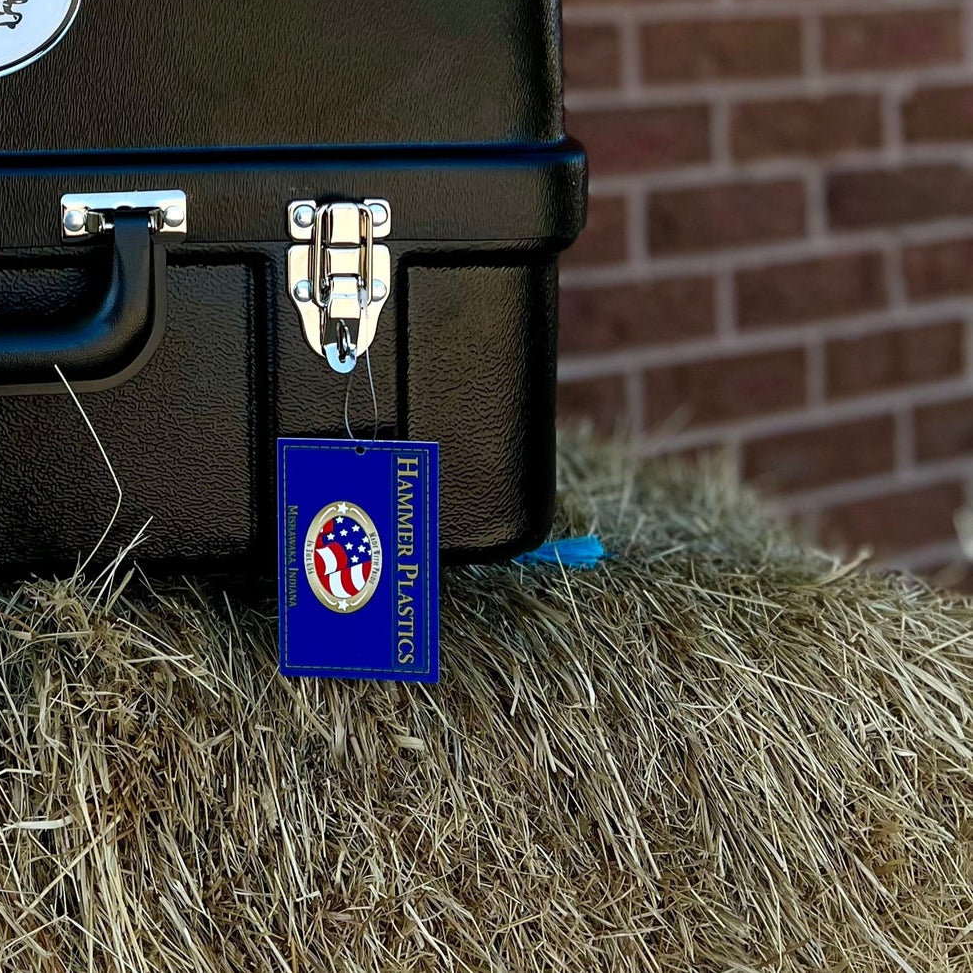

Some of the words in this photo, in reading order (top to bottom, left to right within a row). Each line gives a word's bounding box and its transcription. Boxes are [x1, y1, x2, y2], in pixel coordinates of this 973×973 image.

[397, 456, 419, 557] HAMMER
[288, 567, 299, 607] INDIANA
[397, 563, 419, 665] PLASTICS
